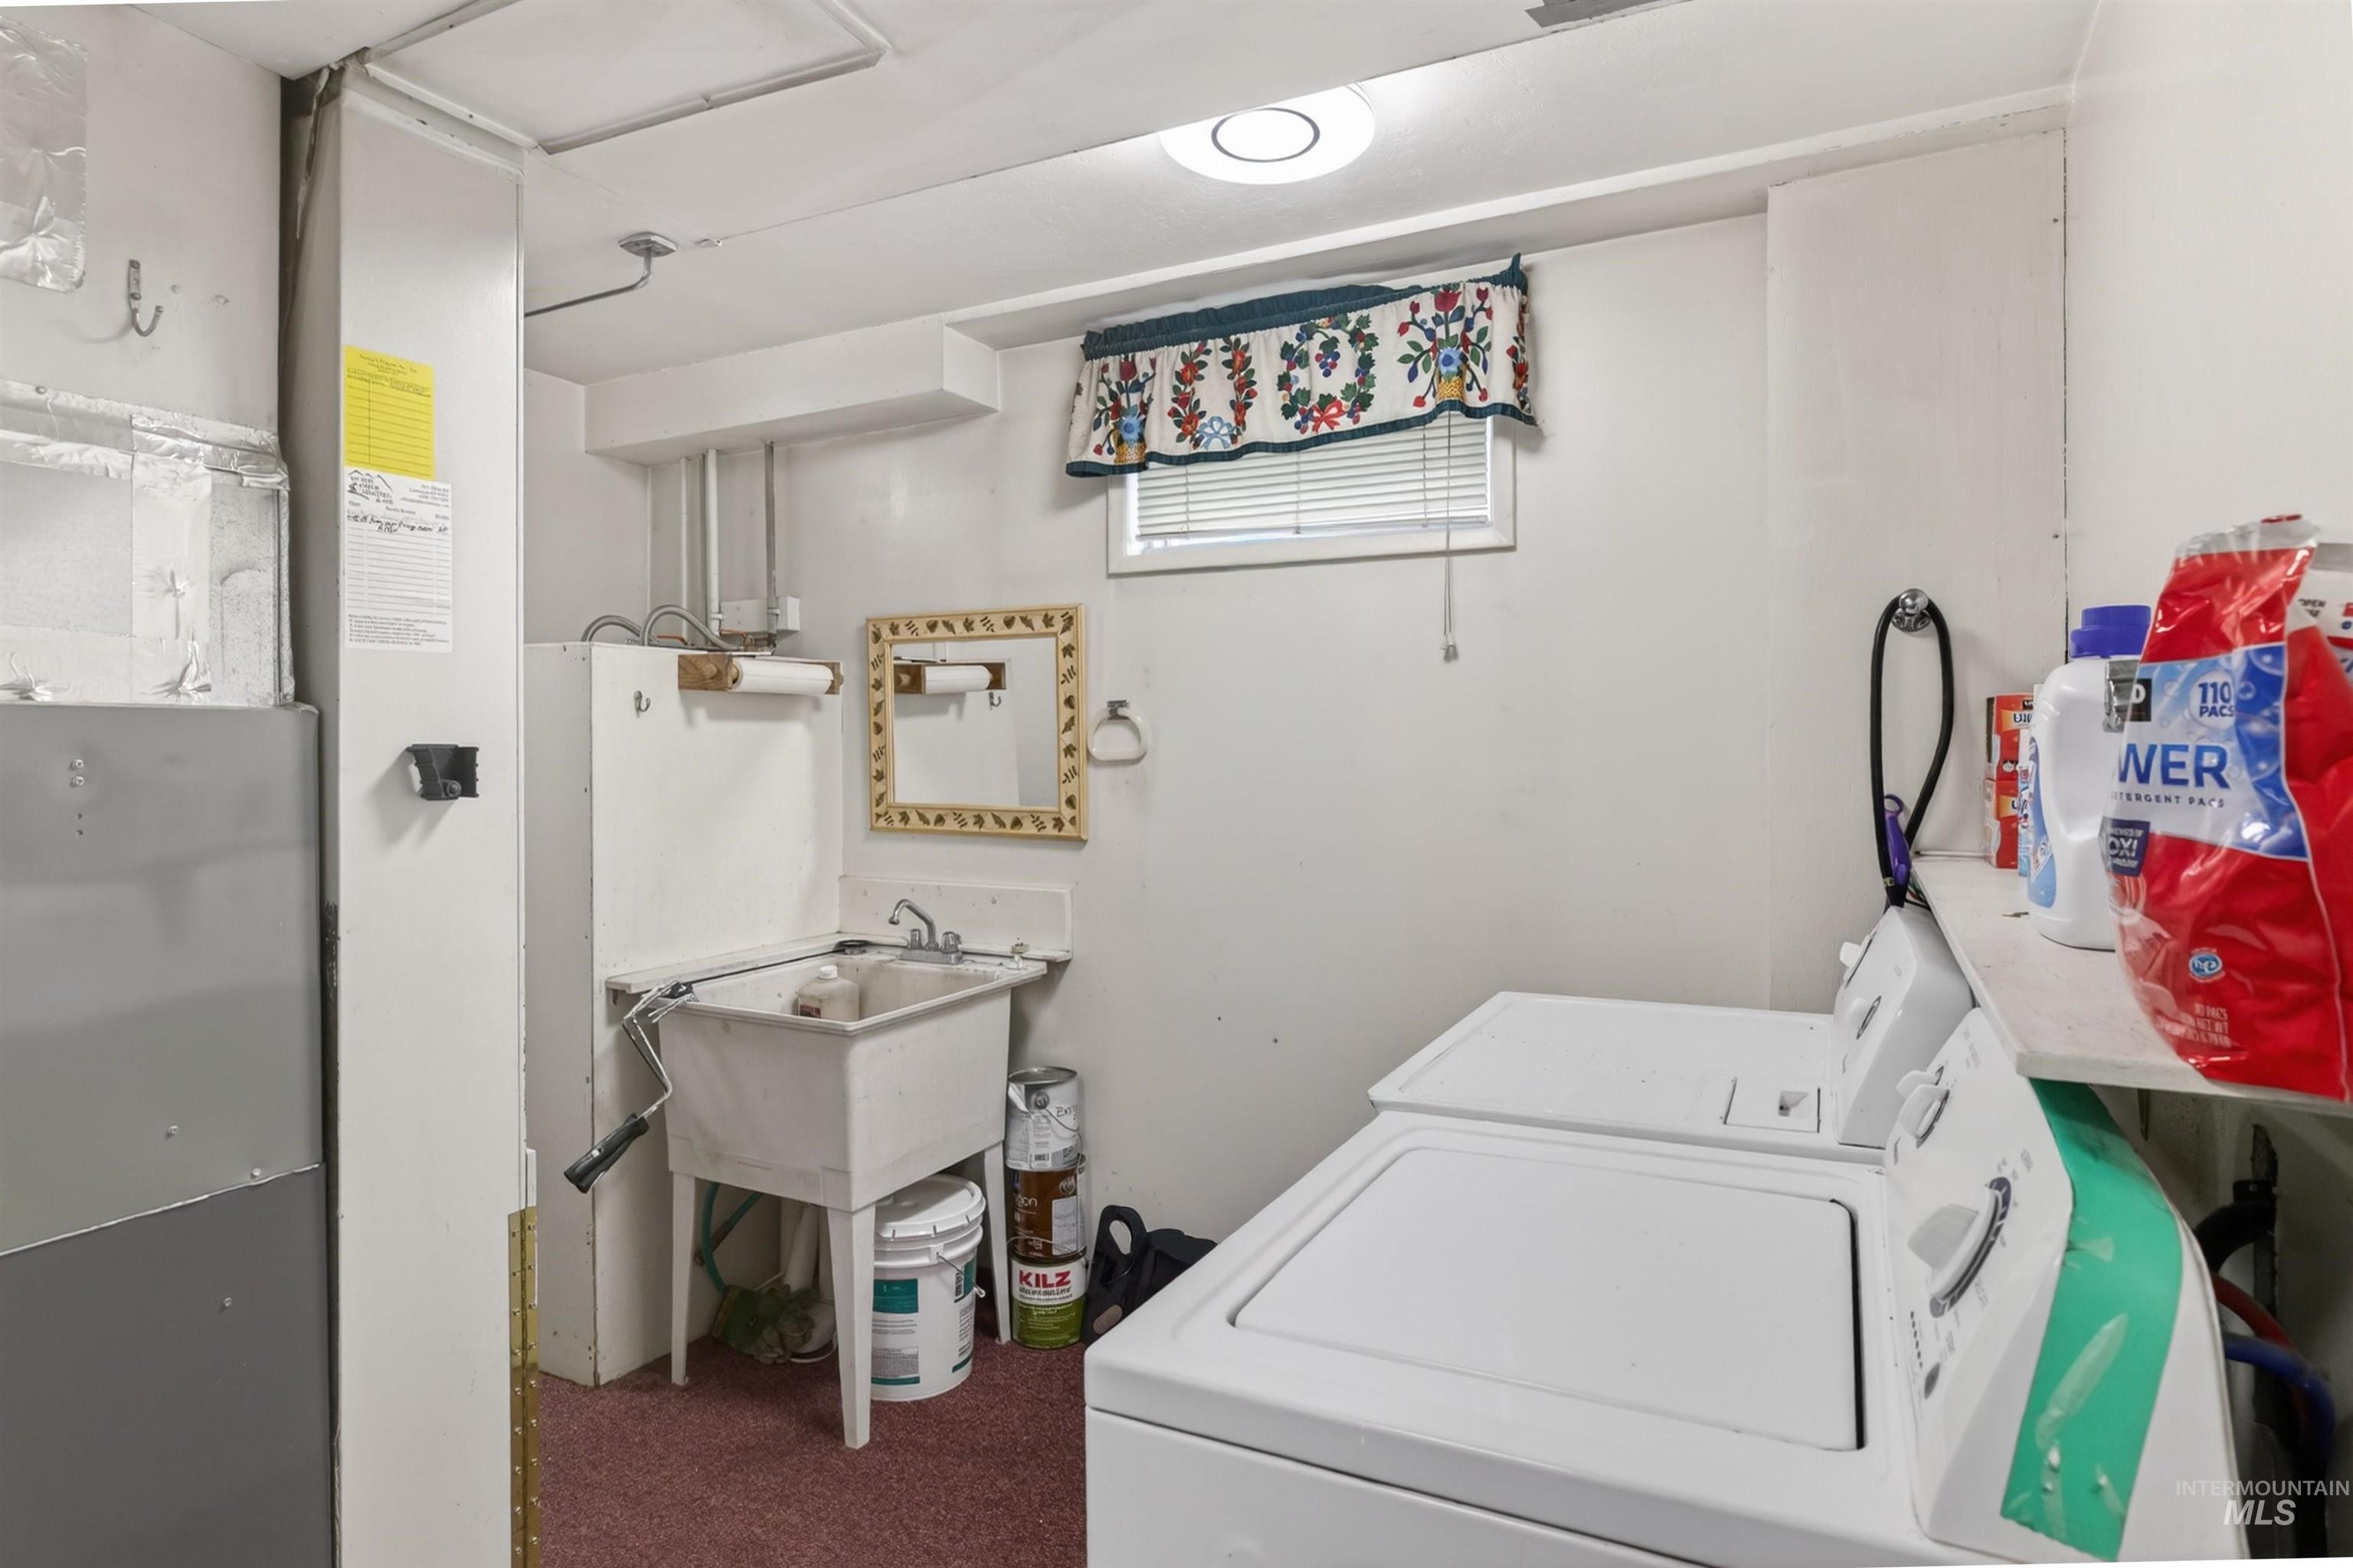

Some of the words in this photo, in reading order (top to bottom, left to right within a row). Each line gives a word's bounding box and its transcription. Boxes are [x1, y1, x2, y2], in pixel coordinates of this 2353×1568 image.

[2198, 681, 2232, 704] 110
[2199, 705, 2235, 718] PACS
[2108, 835, 2138, 857] OXI
[1018, 1269, 1071, 1288] KILZ
